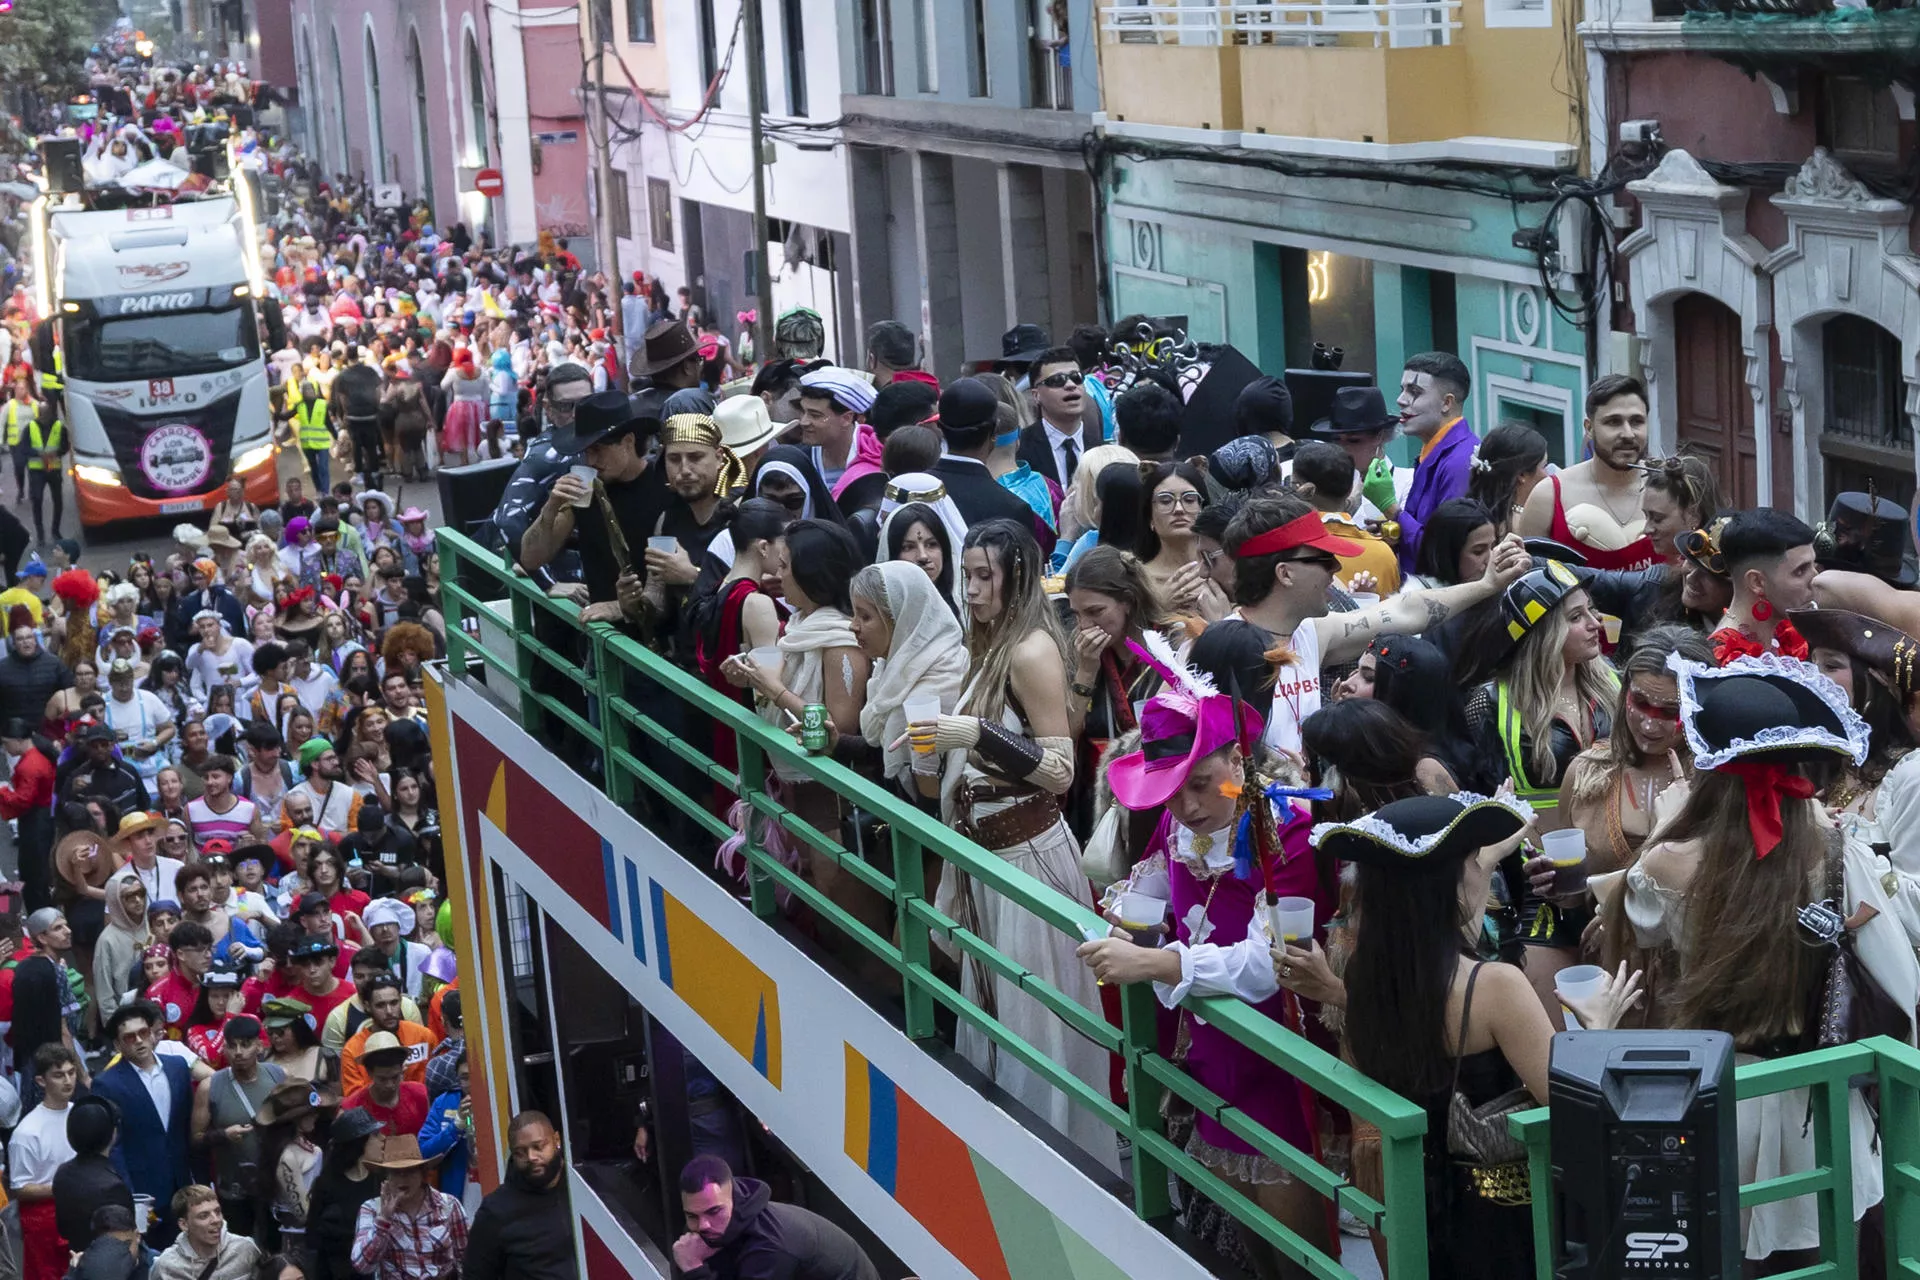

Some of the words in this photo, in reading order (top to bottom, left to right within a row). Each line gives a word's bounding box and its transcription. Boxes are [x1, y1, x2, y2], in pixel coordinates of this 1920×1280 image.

[120, 292, 193, 314] PAPITO
[152, 381, 170, 396] 38
[139, 392, 197, 408] IVO
[149, 427, 197, 448] CARROZA
[164, 440, 183, 449] LOS
[156, 466, 202, 486] SIEMPRE
[171, 467, 185, 475] DE
[1676, 1220, 1688, 1229] 18
[1625, 1232, 1689, 1259] SP
